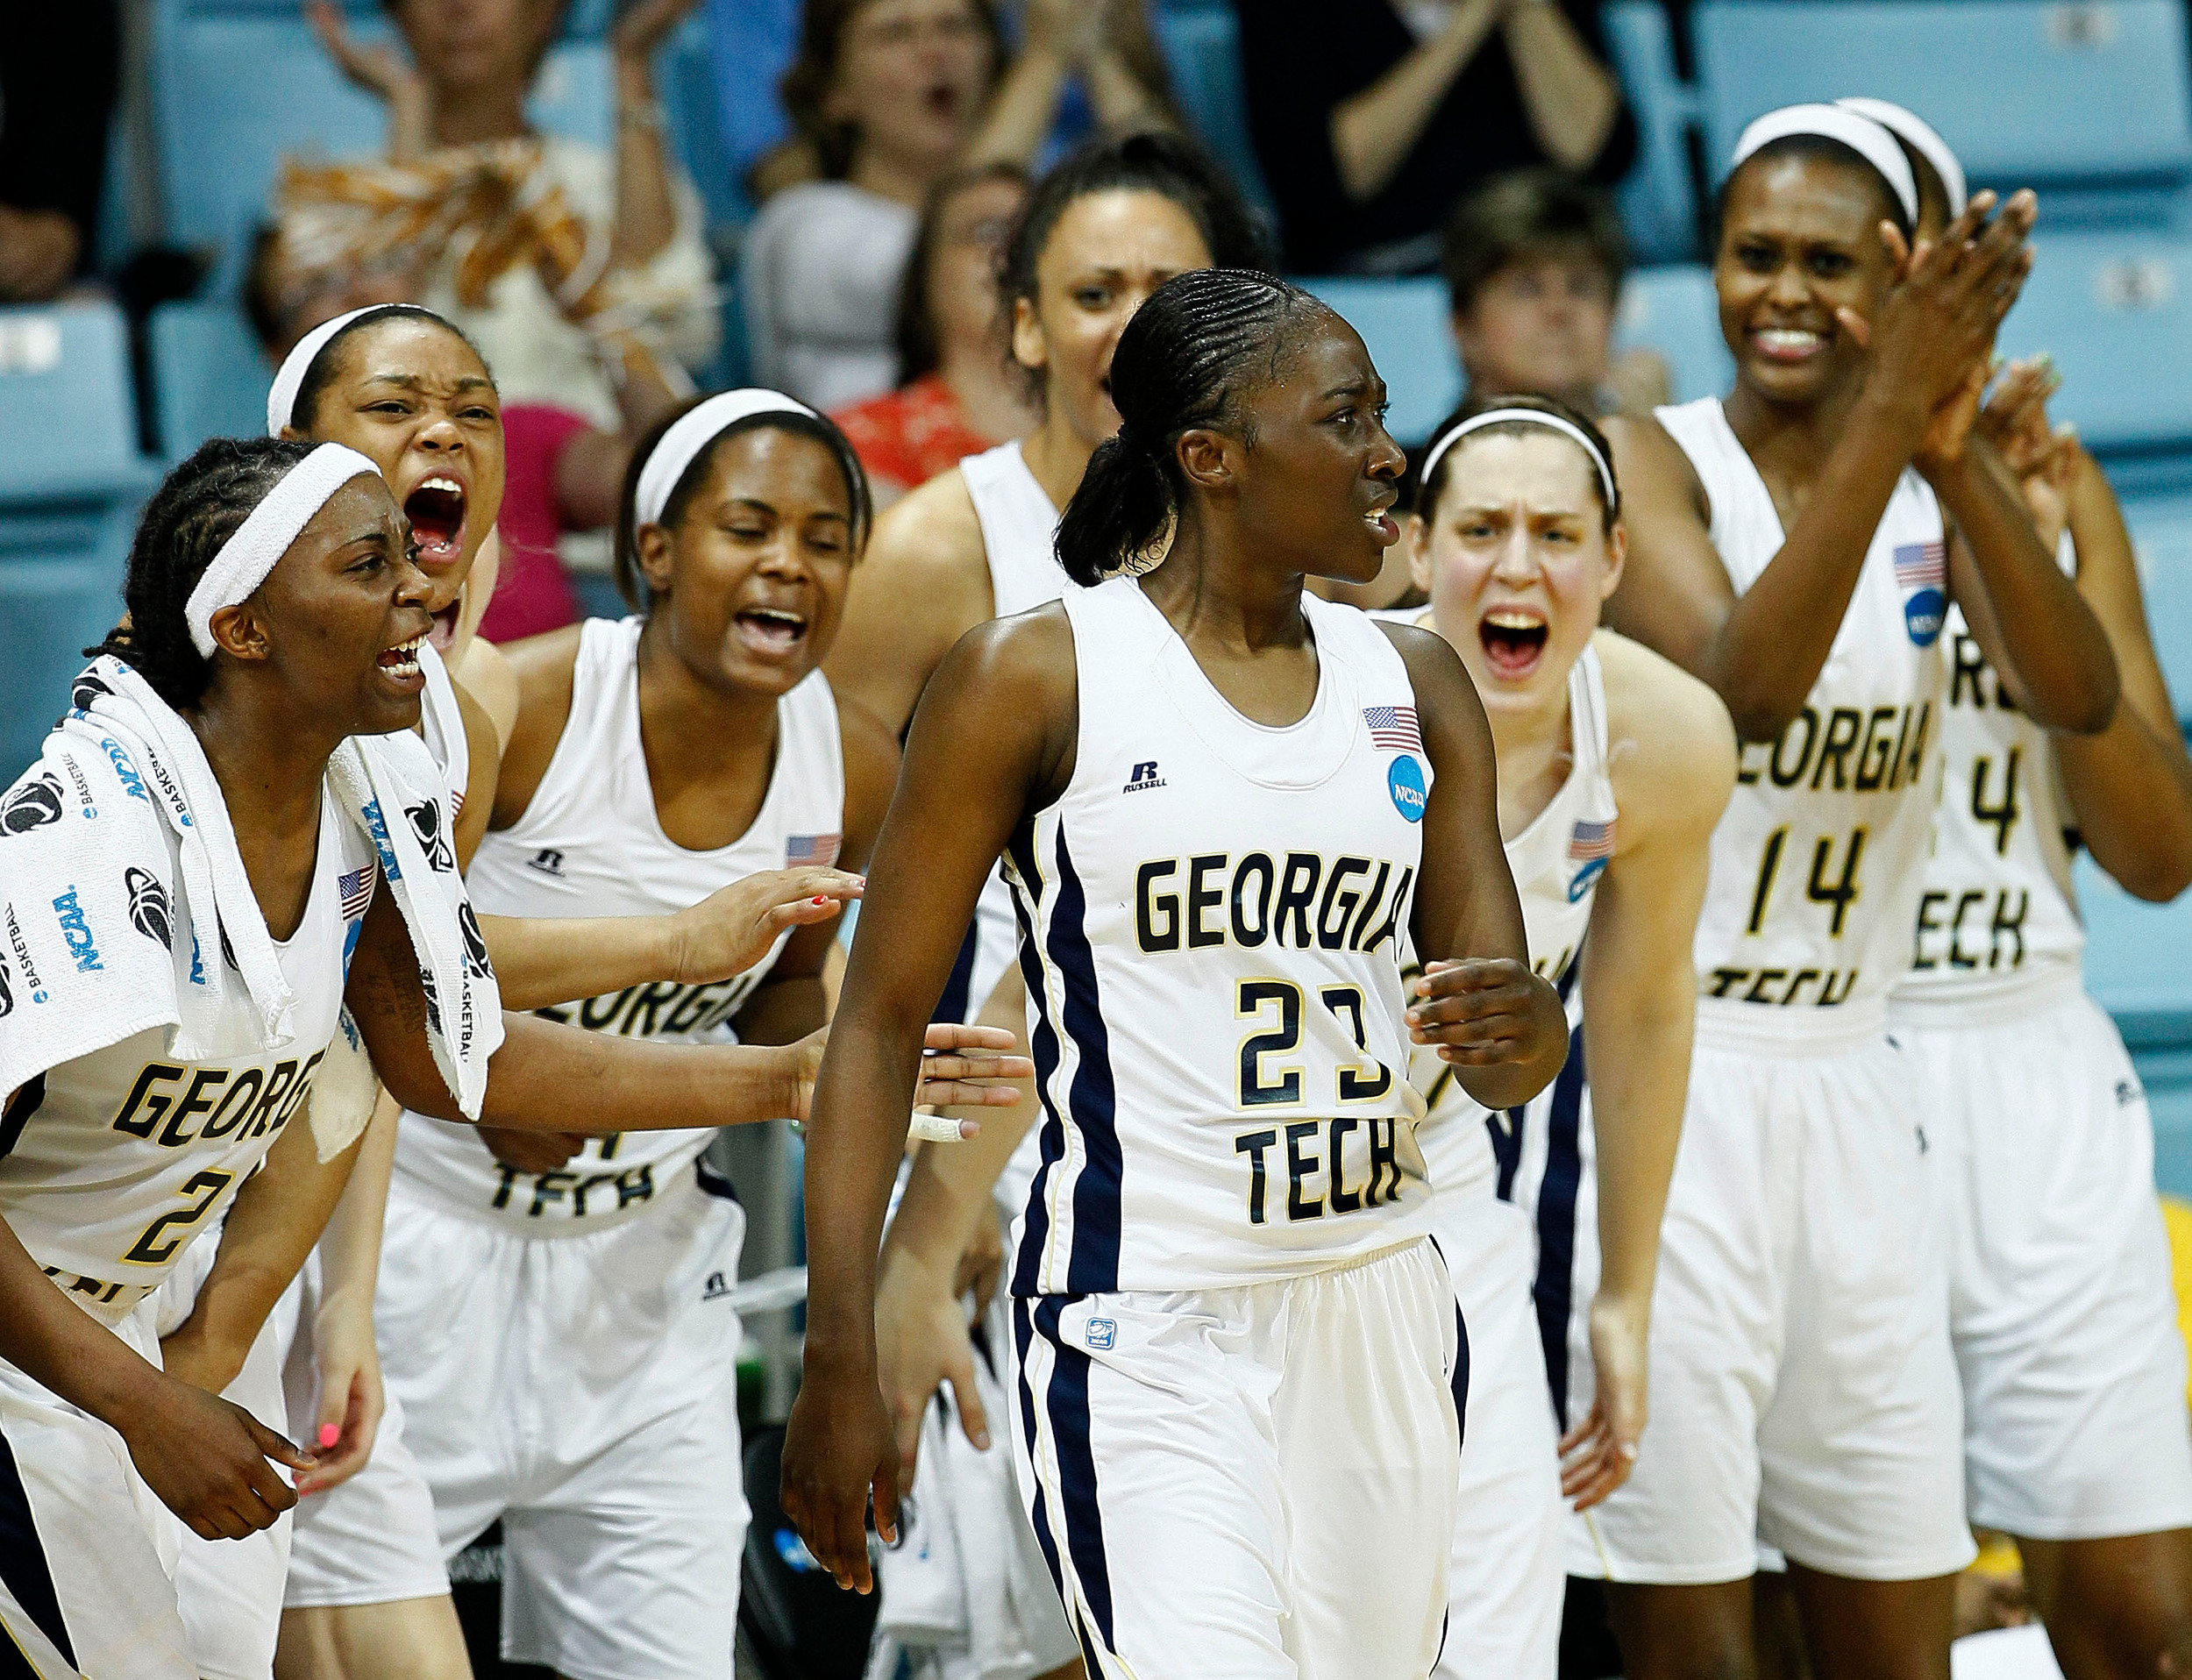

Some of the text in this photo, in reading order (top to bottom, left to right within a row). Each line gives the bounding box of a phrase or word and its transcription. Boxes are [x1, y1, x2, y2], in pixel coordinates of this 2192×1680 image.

[1122, 778, 1168, 794] RUSSELL
[1739, 701, 1932, 792] ORGIA
[1395, 783, 1426, 809] NCAA
[1134, 850, 1414, 963] GEORGIA
[1744, 822, 1869, 940] 14
[5, 901, 42, 989] BASKETBALL
[51, 889, 104, 974] NCAA
[1912, 886, 2029, 972] ECH
[1235, 977, 1392, 1112] 23
[1233, 1119, 1405, 1227] TECH
